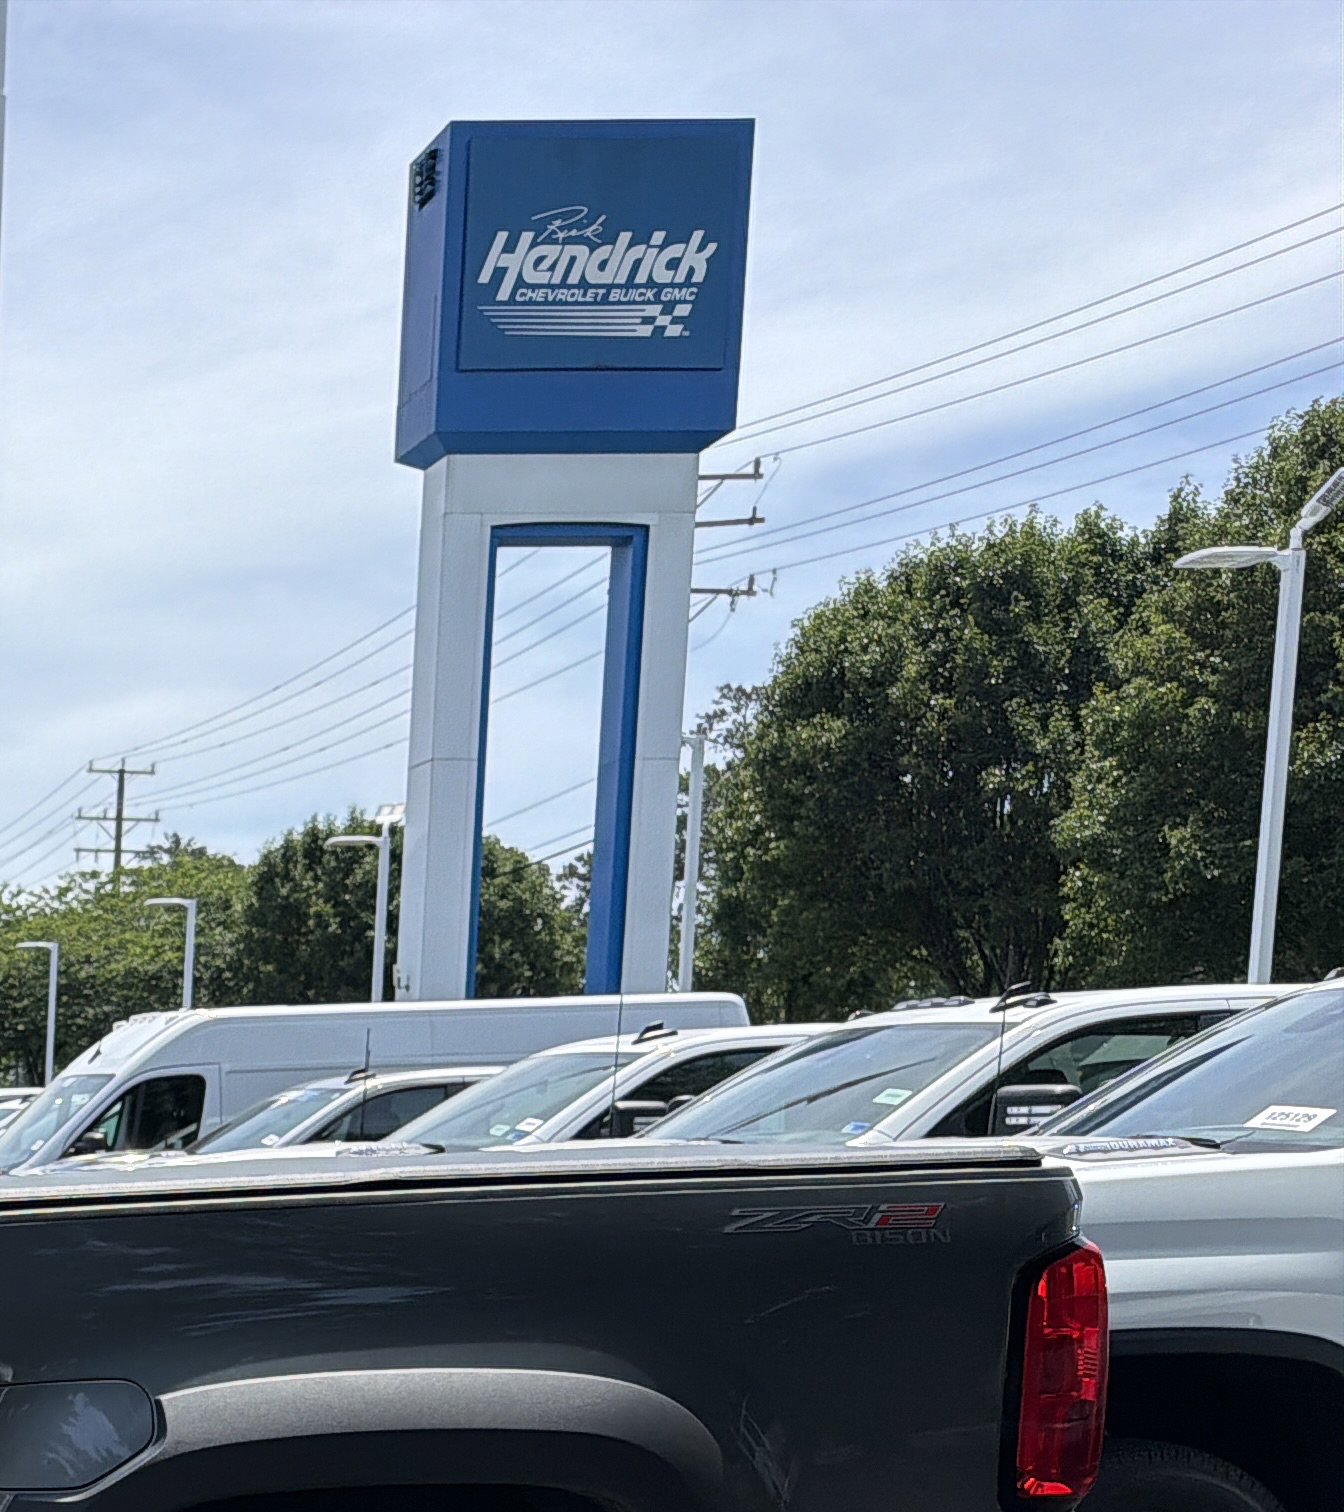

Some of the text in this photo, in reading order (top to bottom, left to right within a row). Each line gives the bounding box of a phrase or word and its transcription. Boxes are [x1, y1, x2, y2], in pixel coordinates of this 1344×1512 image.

[477, 229, 718, 302] Hendrick
[515, 286, 698, 303] CHEVROLET BUICK GMC
[722, 1202, 947, 1234] ZR2
[849, 1228, 951, 1246] BISON
